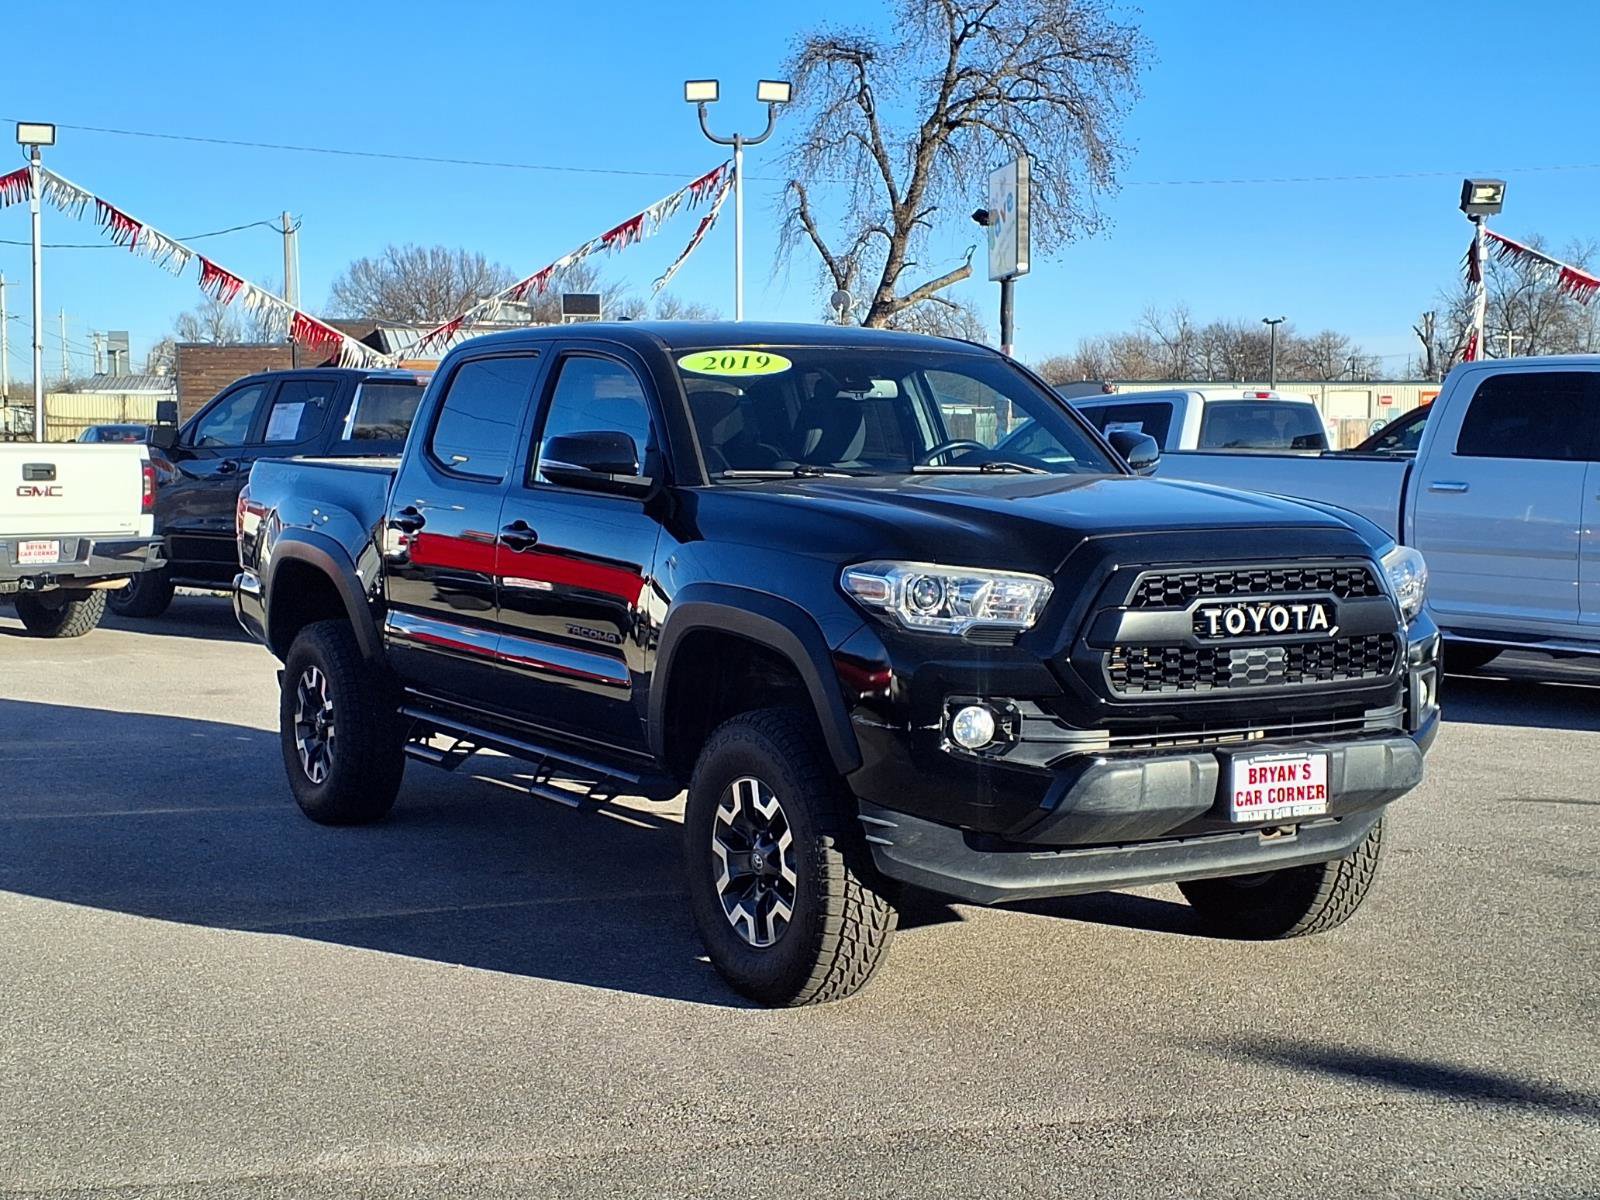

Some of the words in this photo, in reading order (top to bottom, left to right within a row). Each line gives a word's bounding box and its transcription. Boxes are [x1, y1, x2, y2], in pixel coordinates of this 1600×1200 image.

[702, 355, 771, 371] 2019
[16, 485, 63, 497] GMC
[1203, 603, 1329, 635] TOYOTA
[564, 623, 617, 643] TACOMA
[1248, 763, 1312, 785] BRYAN'S
[1236, 790, 1262, 807] CAR
[1267, 784, 1325, 804] CORNER
